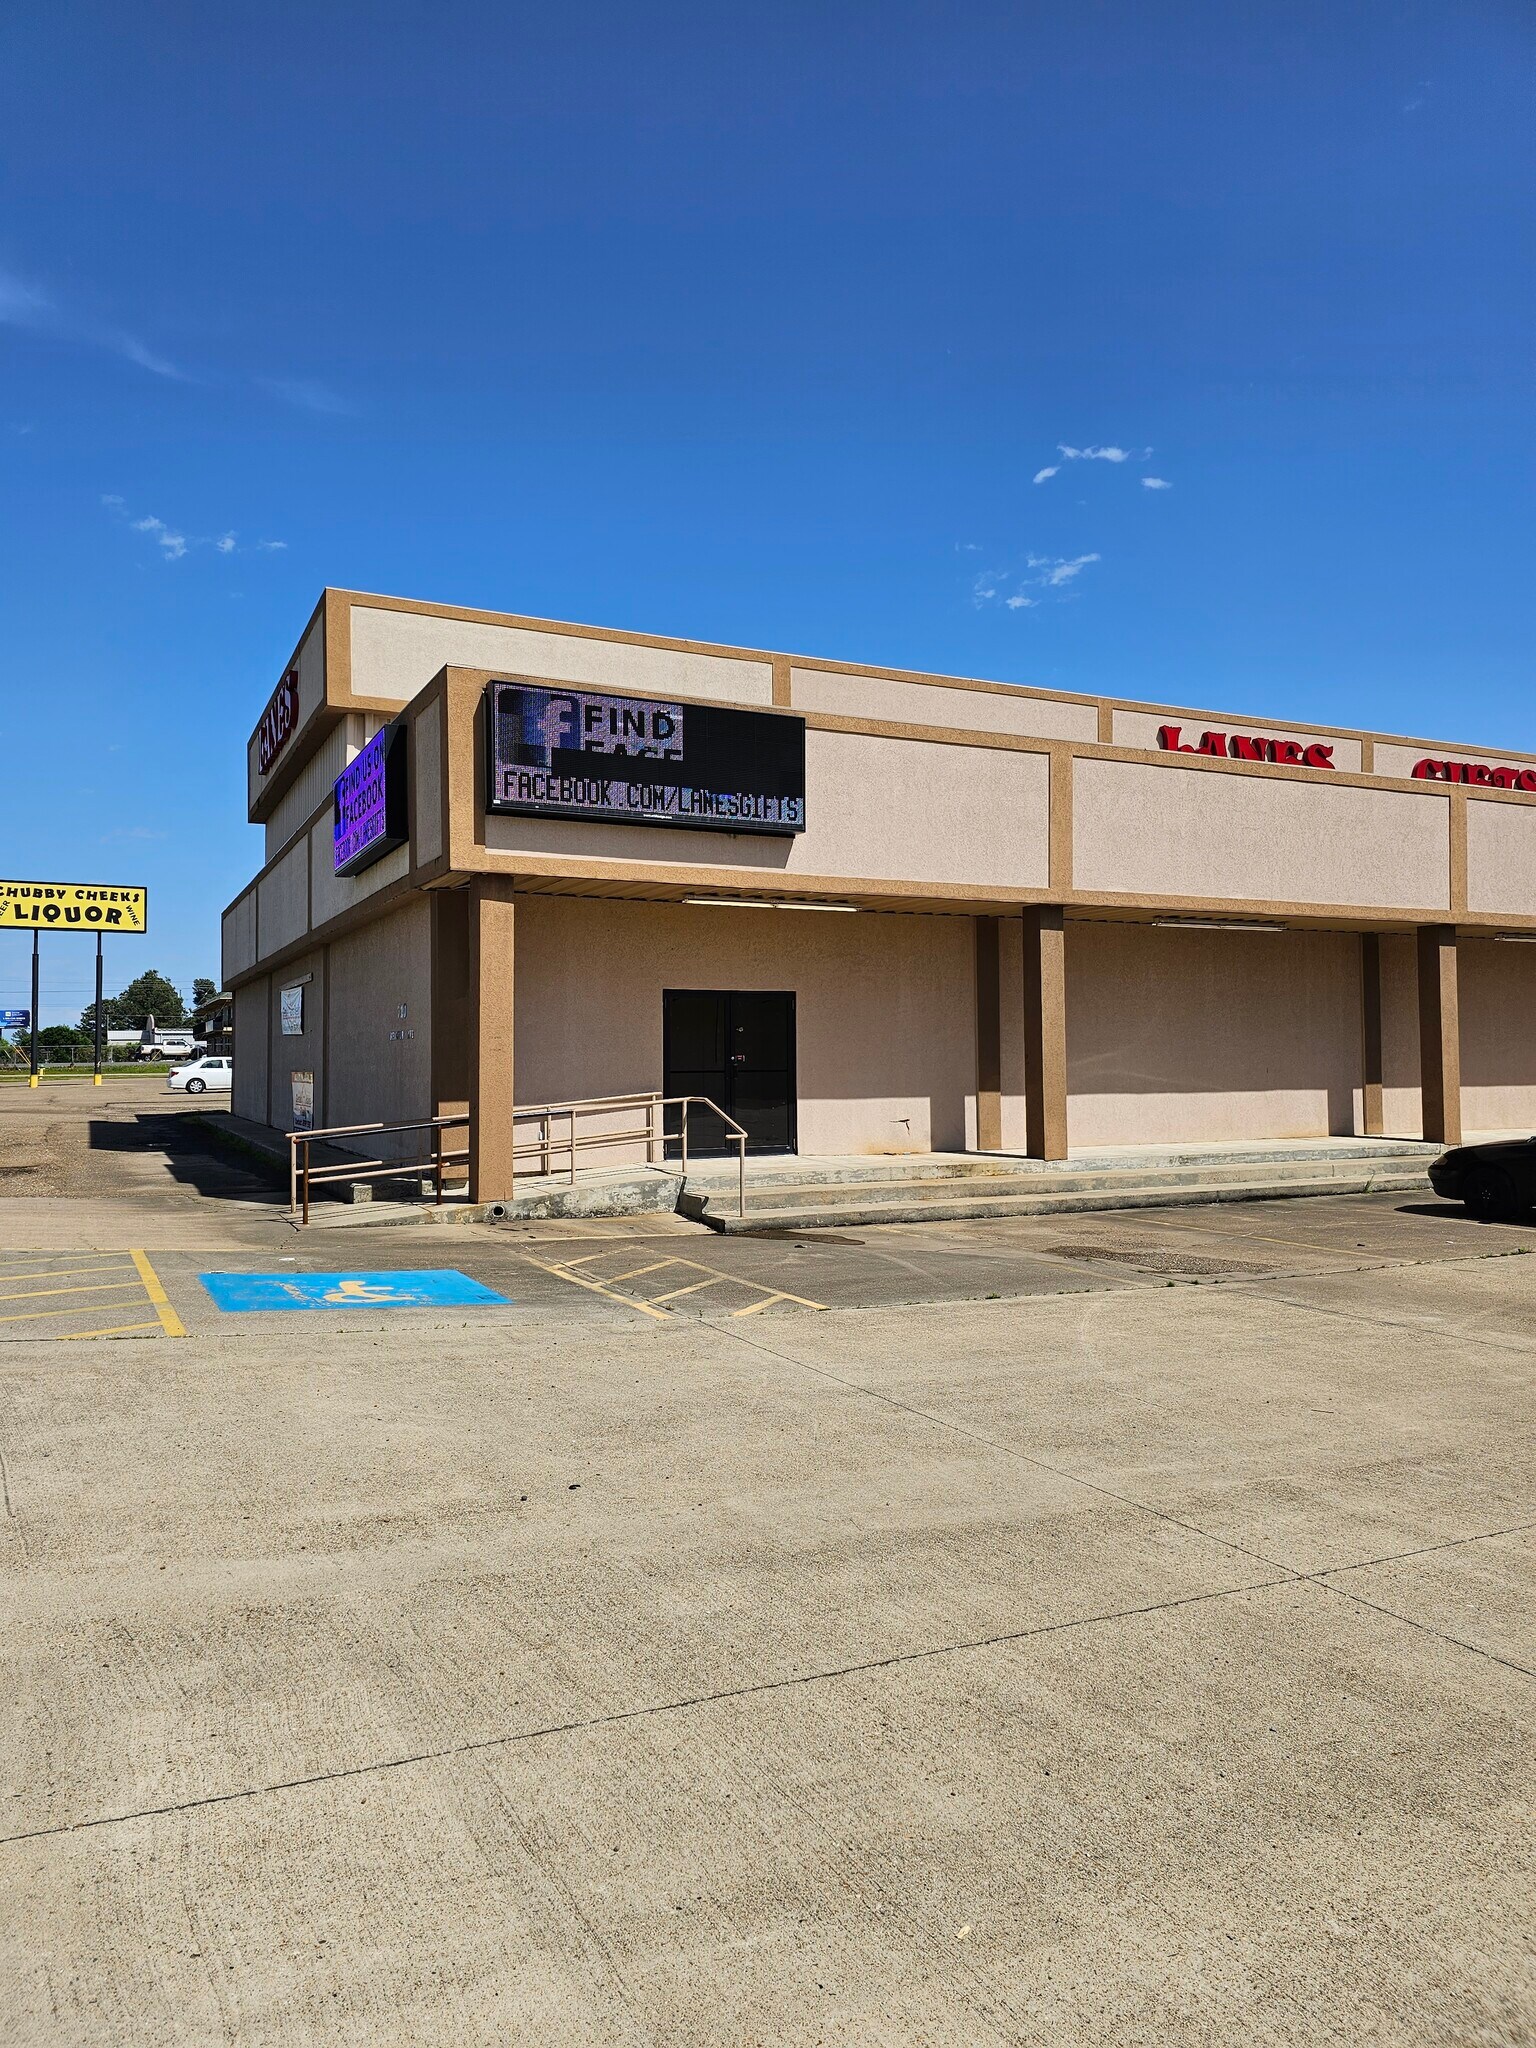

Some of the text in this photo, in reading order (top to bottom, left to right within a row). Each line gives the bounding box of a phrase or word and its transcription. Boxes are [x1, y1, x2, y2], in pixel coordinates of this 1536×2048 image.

[585, 704, 675, 740] FIND
[362, 752, 371, 781] US
[374, 740, 384, 770] ON
[345, 772, 384, 828] FACEBOOK
[75, 890, 140, 903] CHEEKS
[0, 900, 11, 918] EER
[14, 904, 123, 925] LIQUOR
[125, 905, 141, 926] WINE
